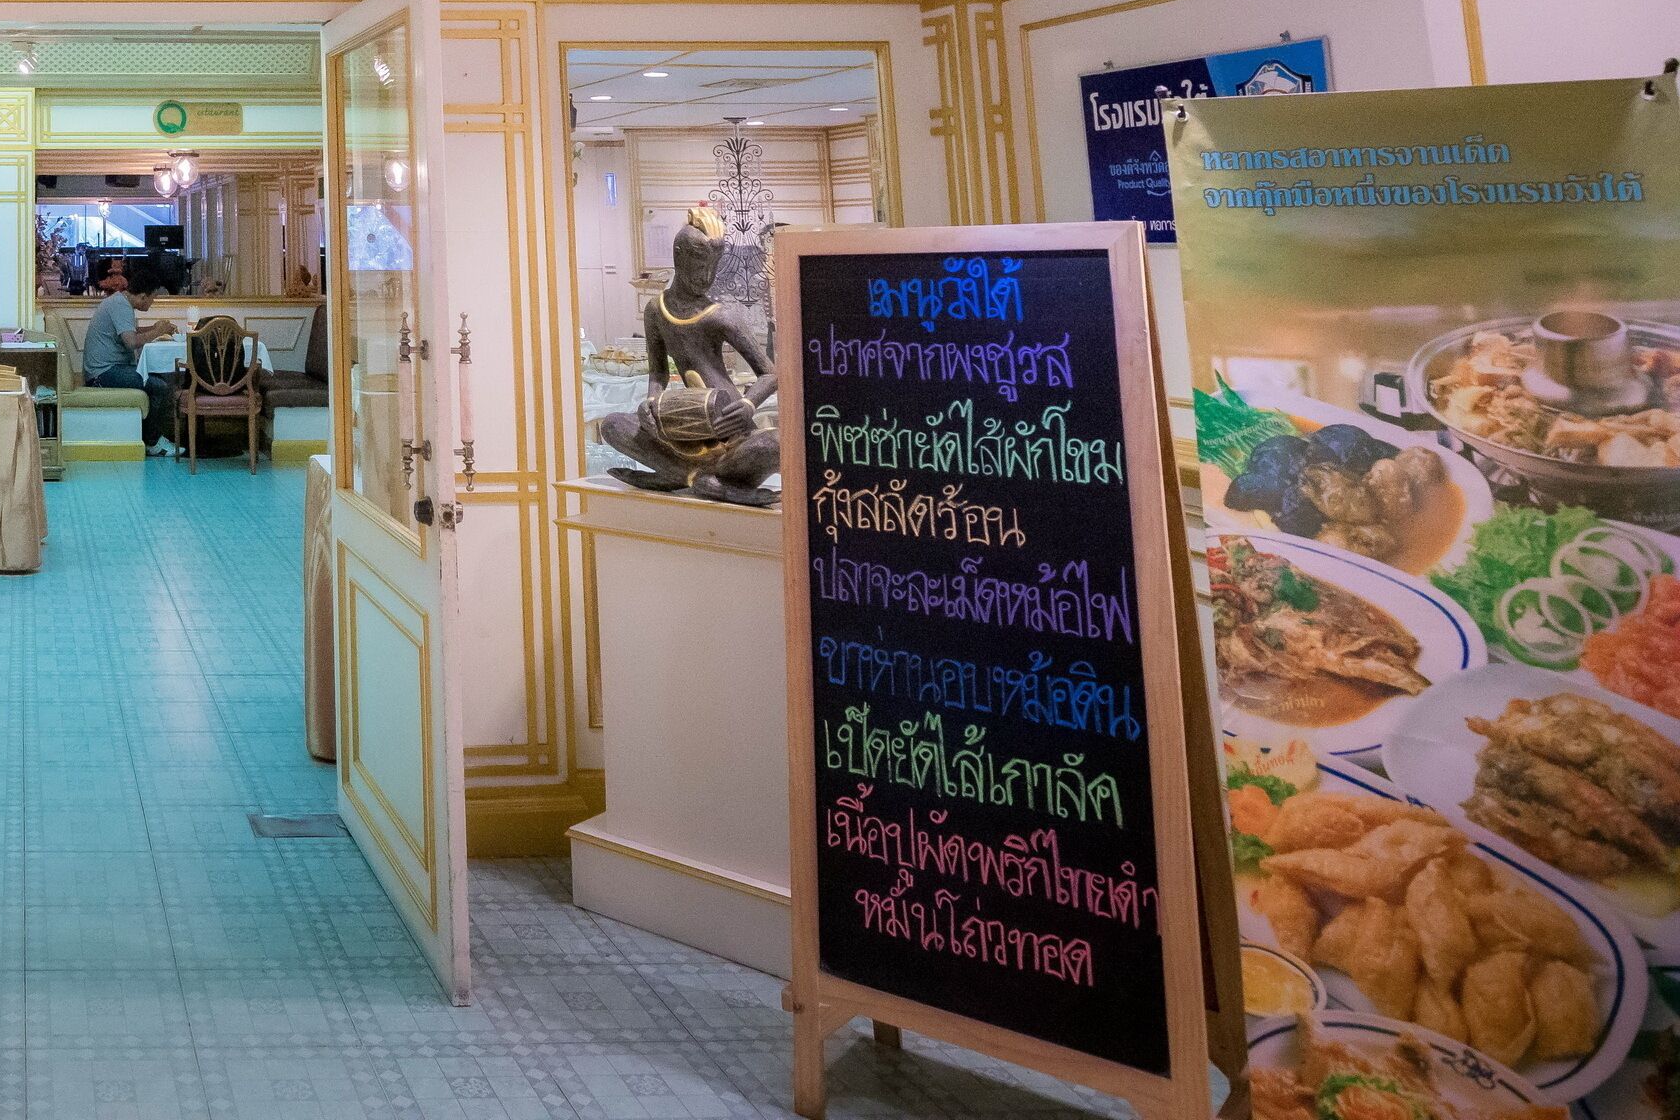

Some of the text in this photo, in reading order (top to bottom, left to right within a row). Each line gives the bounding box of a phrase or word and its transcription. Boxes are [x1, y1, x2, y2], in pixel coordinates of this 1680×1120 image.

[1200, 134, 1512, 170] หลากรสอาหารจานเด็ด
[812, 469, 1026, 548] กุ้งสลัดร้อน
